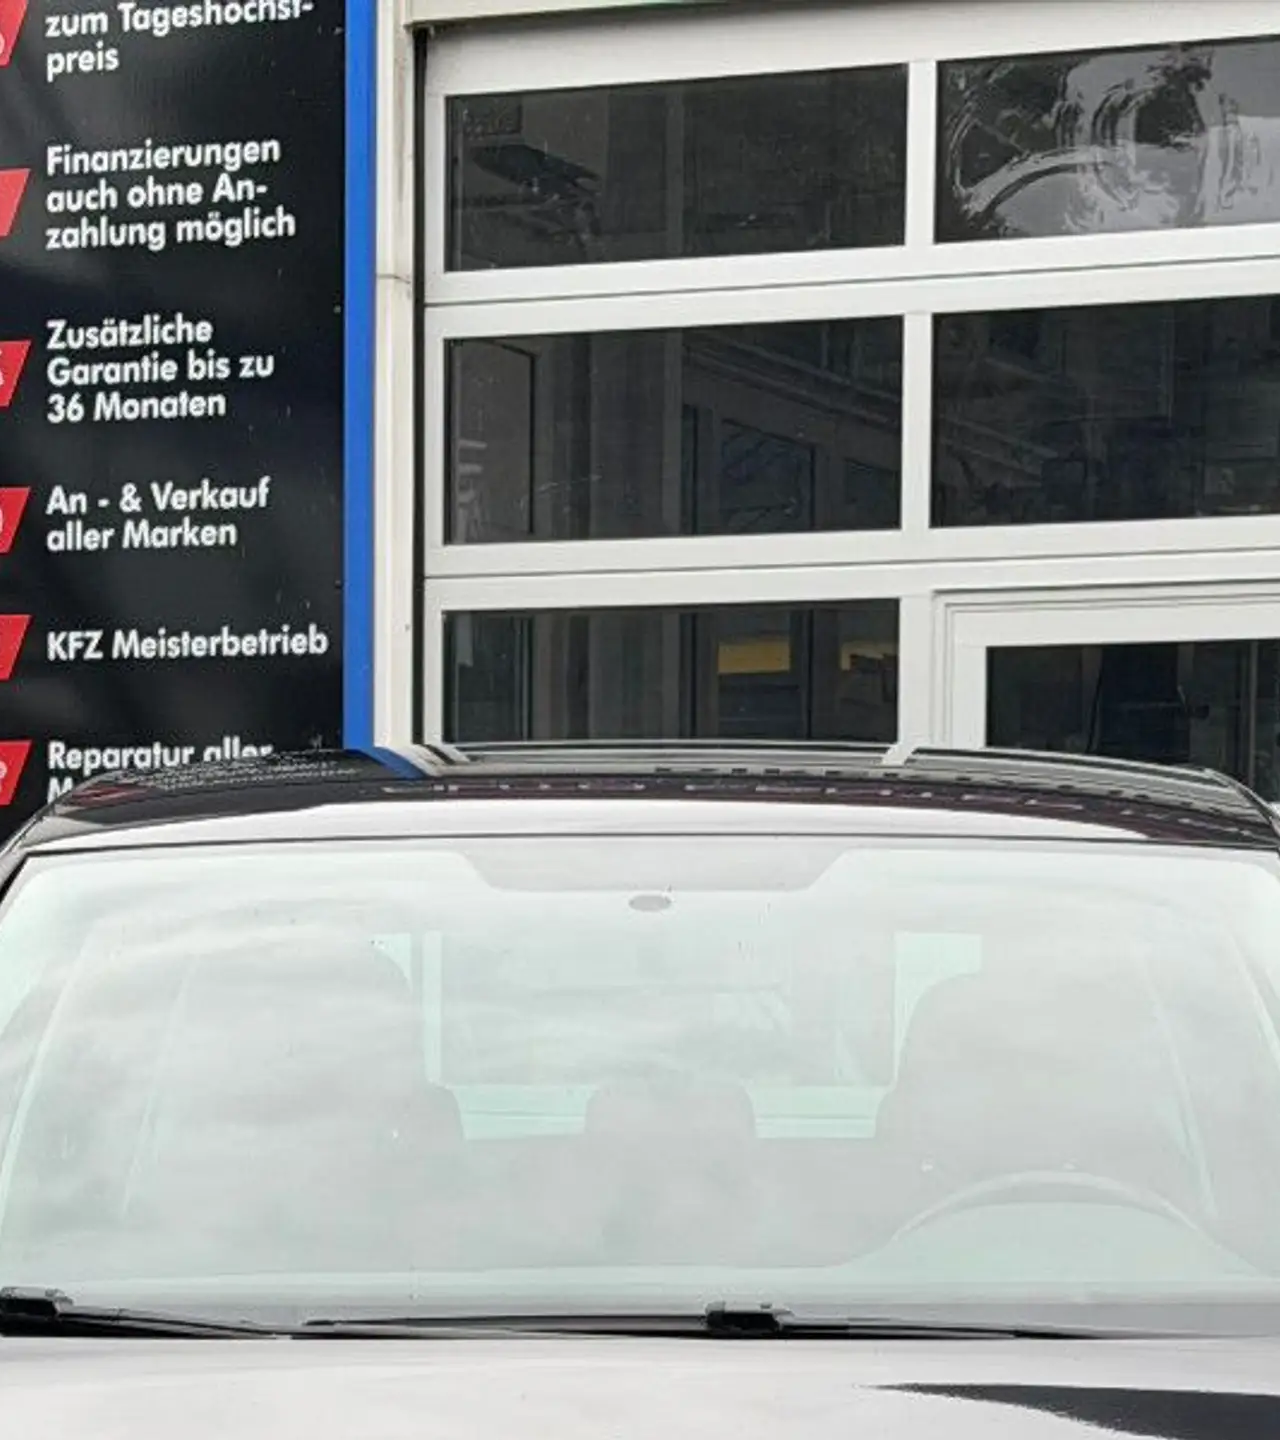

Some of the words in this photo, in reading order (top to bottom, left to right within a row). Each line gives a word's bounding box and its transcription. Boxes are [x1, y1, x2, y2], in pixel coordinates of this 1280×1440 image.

[45, 11, 109, 38] zum
[45, 40, 120, 83] preis
[46, 137, 281, 177] Finanzierungen
[45, 177, 119, 213] auch
[127, 175, 204, 208] ohne
[211, 172, 269, 203] An-
[44, 215, 167, 251] zahlung
[176, 204, 297, 247] möglich
[46, 311, 214, 350] Zusätzliche
[46, 350, 179, 387] Garantie
[186, 348, 231, 381] bis
[238, 354, 275, 379] zu
[46, 393, 86, 424] 36
[93, 390, 227, 422] Monaten
[45, 484, 88, 515] An
[120, 482, 143, 513] &
[150, 475, 272, 511] Verkauf
[46, 519, 116, 551] aller
[122, 516, 238, 550] Marken
[46, 629, 104, 661] KFZ
[111, 622, 330, 660] Meisterbetrieb
[47, 739, 196, 776] Reparatur
